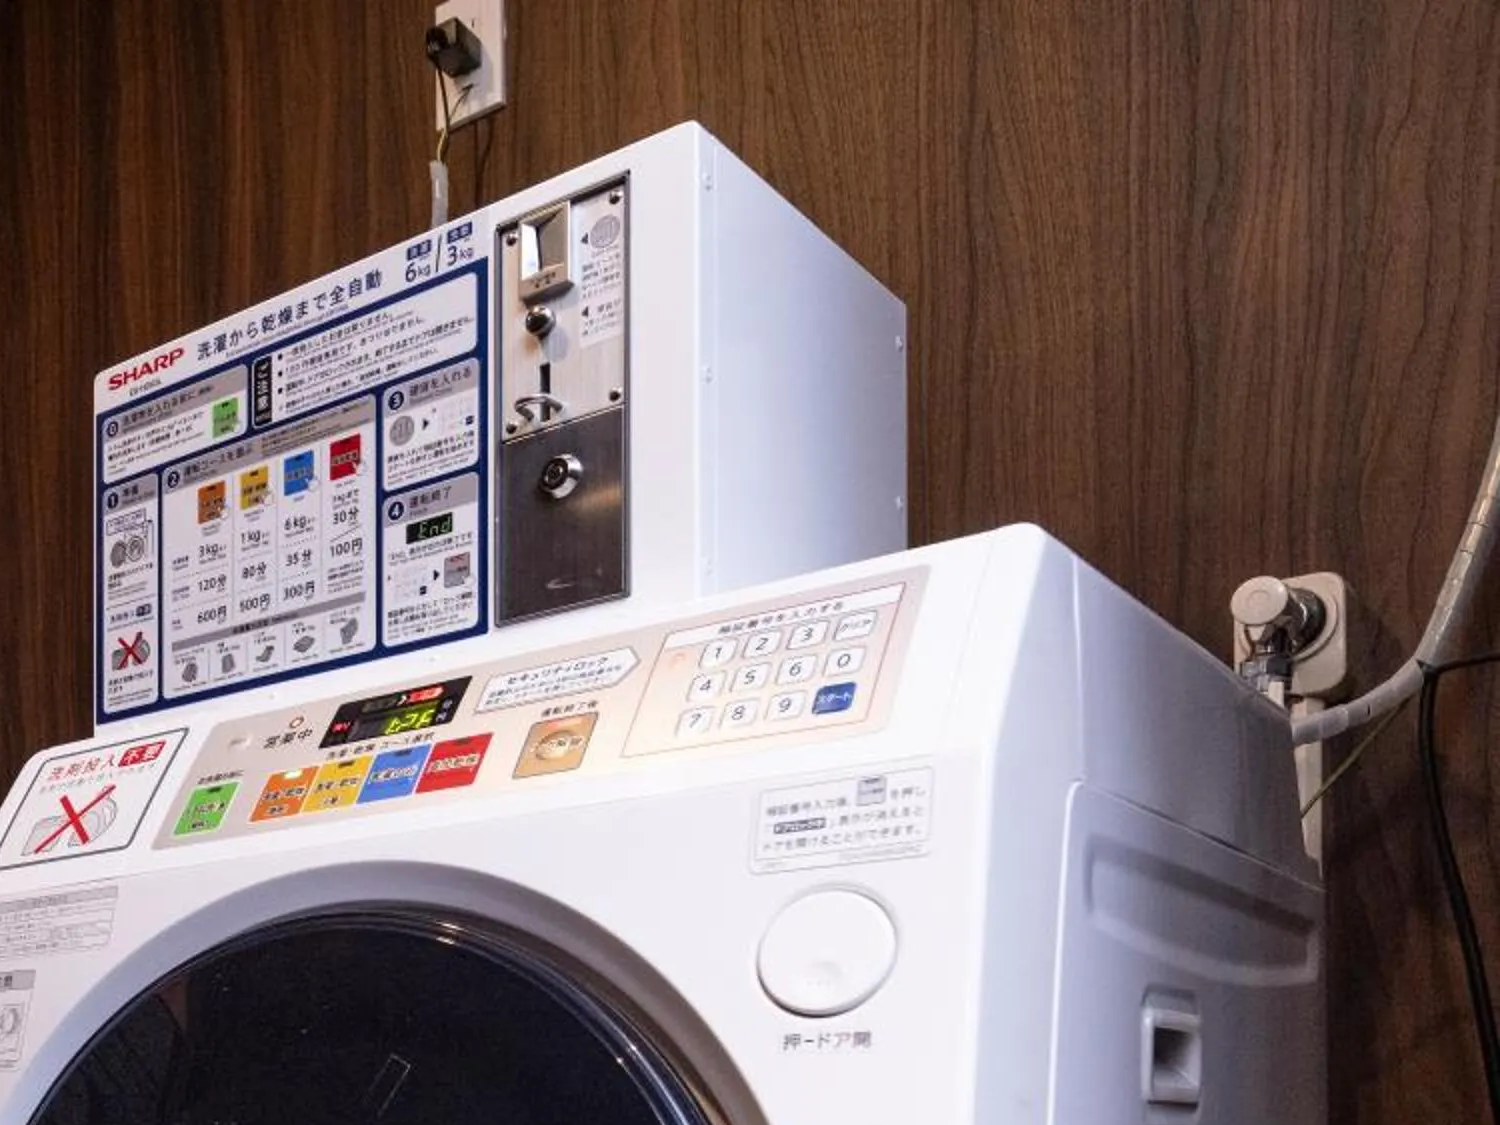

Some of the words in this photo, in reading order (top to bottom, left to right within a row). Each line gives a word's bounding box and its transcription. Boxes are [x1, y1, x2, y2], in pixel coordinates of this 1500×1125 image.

[405, 261, 432, 284] 6kg
[447, 244, 474, 268] 3kg
[197, 268, 383, 362] 洗濯から乾燥まで全自動
[108, 347, 185, 392] SHARP
[330, 537, 363, 558] 100円
[198, 573, 227, 592] 120分
[714, 646, 723, 660] 1
[755, 637, 768, 651] 2
[802, 627, 813, 641] 3
[700, 678, 711, 692] 4
[744, 670, 755, 684] 5
[789, 661, 801, 675] 6
[837, 653, 851, 668] 0
[689, 714, 701, 729] 7
[731, 705, 745, 720] 8
[779, 699, 792, 713] 9
